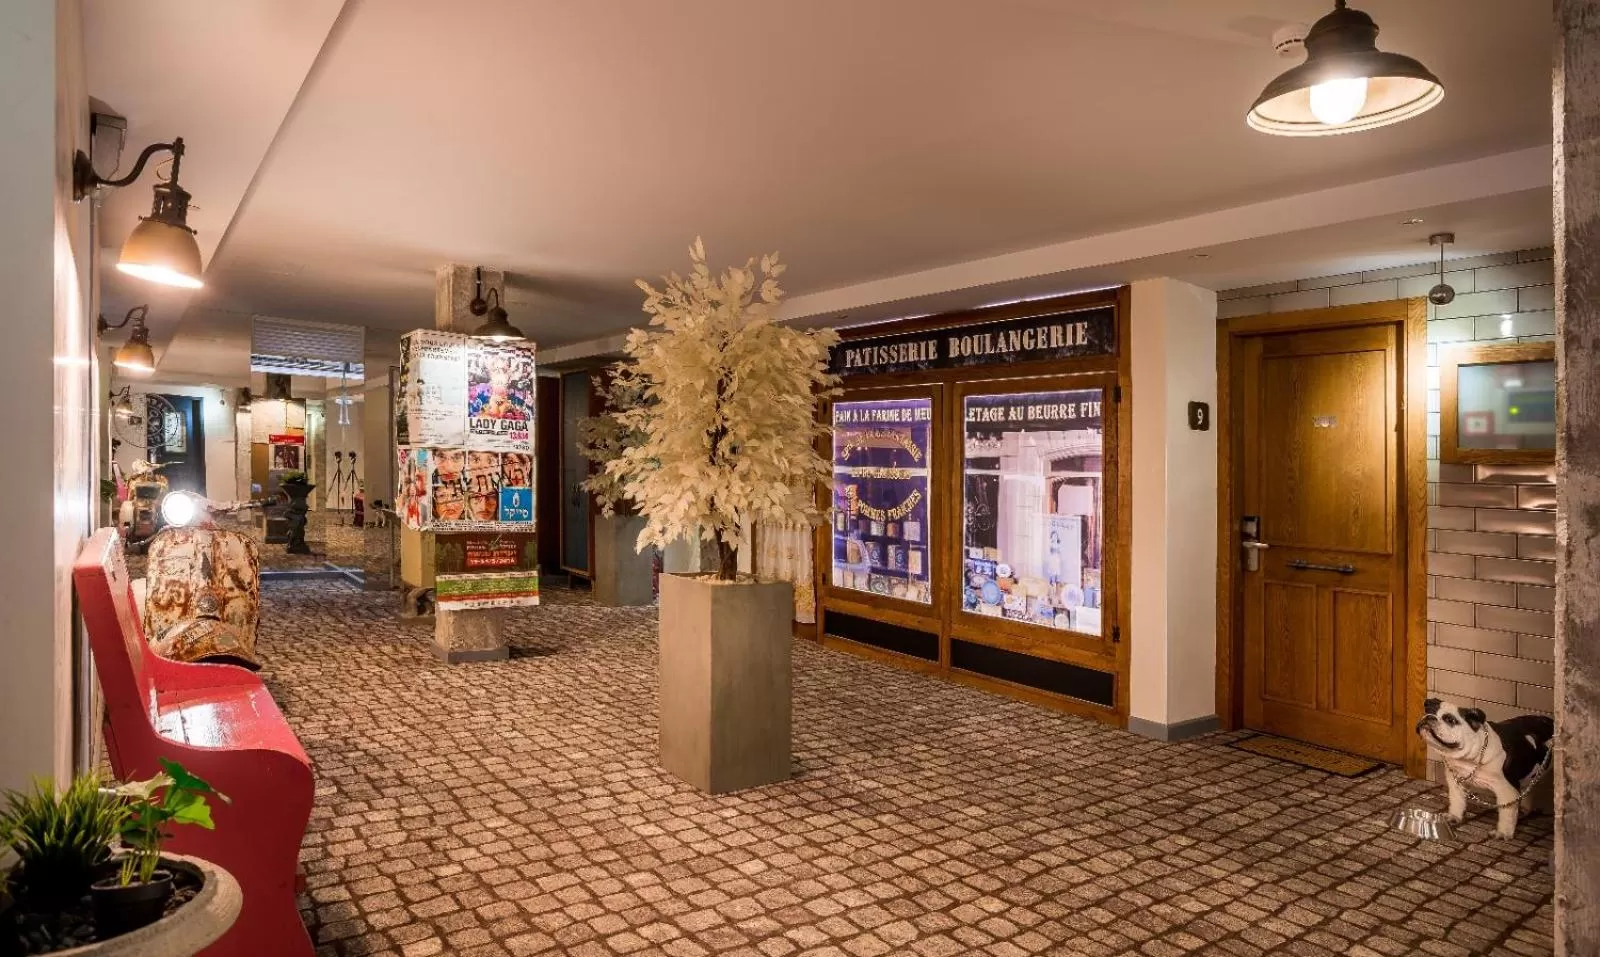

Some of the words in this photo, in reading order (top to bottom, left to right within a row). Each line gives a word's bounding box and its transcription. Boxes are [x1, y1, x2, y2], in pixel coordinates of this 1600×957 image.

[845, 340, 938, 368] PATISSERIE
[948, 321, 1088, 358] BOULANGERIE
[860, 409, 869, 422] LA
[871, 408, 900, 422] FARINE
[901, 408, 912, 422] DE
[1007, 405, 1025, 421] AU
[1027, 402, 1077, 420] BEURRE
[1079, 401, 1101, 418] FIN
[1197, 408, 1204, 425] 9
[469, 417, 497, 430] LADY
[500, 419, 529, 432] GAGA
